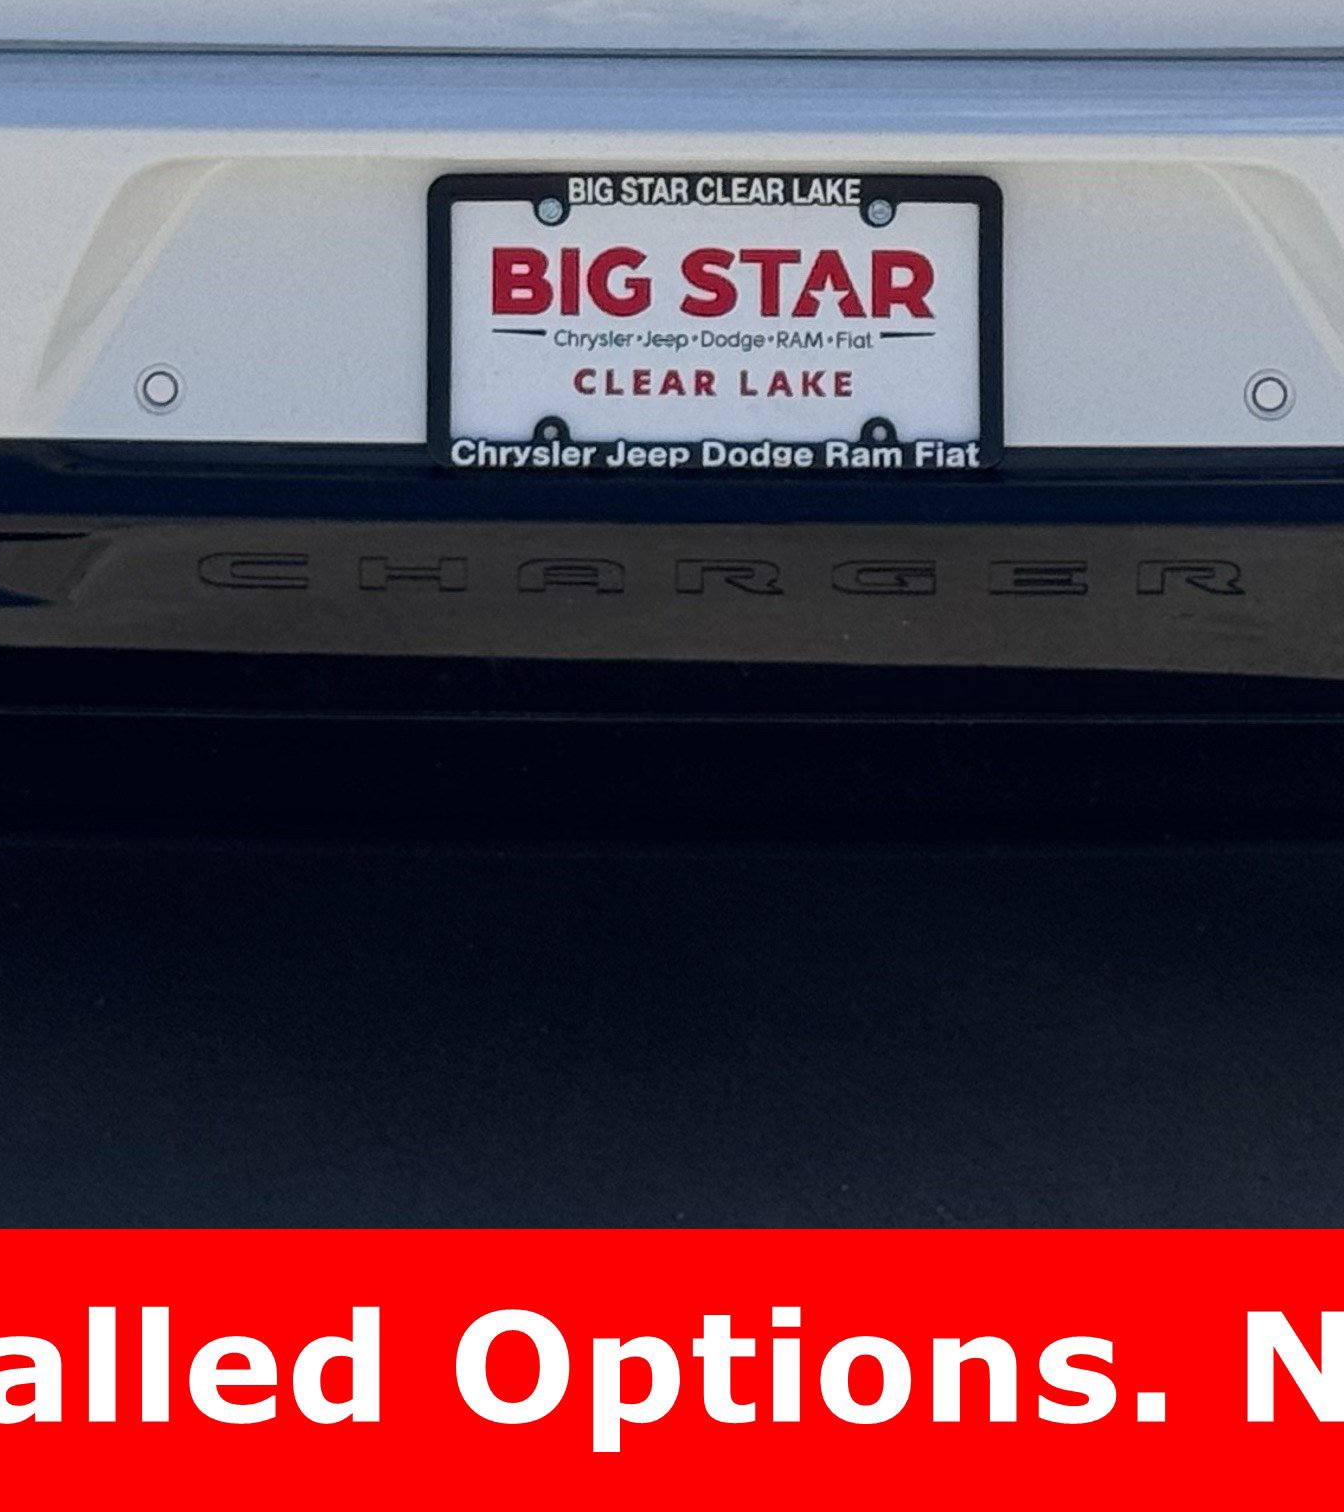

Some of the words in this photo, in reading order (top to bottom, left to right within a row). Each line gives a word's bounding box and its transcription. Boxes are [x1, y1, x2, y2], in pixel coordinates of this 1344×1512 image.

[568, 177, 614, 204] BIG
[621, 177, 689, 204] STAR
[695, 177, 785, 205] CLEAR
[792, 178, 862, 205] LAKE
[492, 246, 652, 317] BIG
[679, 247, 935, 319] STAR
[573, 368, 716, 396] CLEAR
[740, 369, 853, 397] LAKE
[451, 439, 597, 468] Chrysler
[606, 440, 690, 468] Jeep
[702, 440, 814, 468] Dodge
[825, 441, 902, 469] Ram
[915, 441, 981, 469] Fiat
[197, 550, 1246, 597] CHARGER
